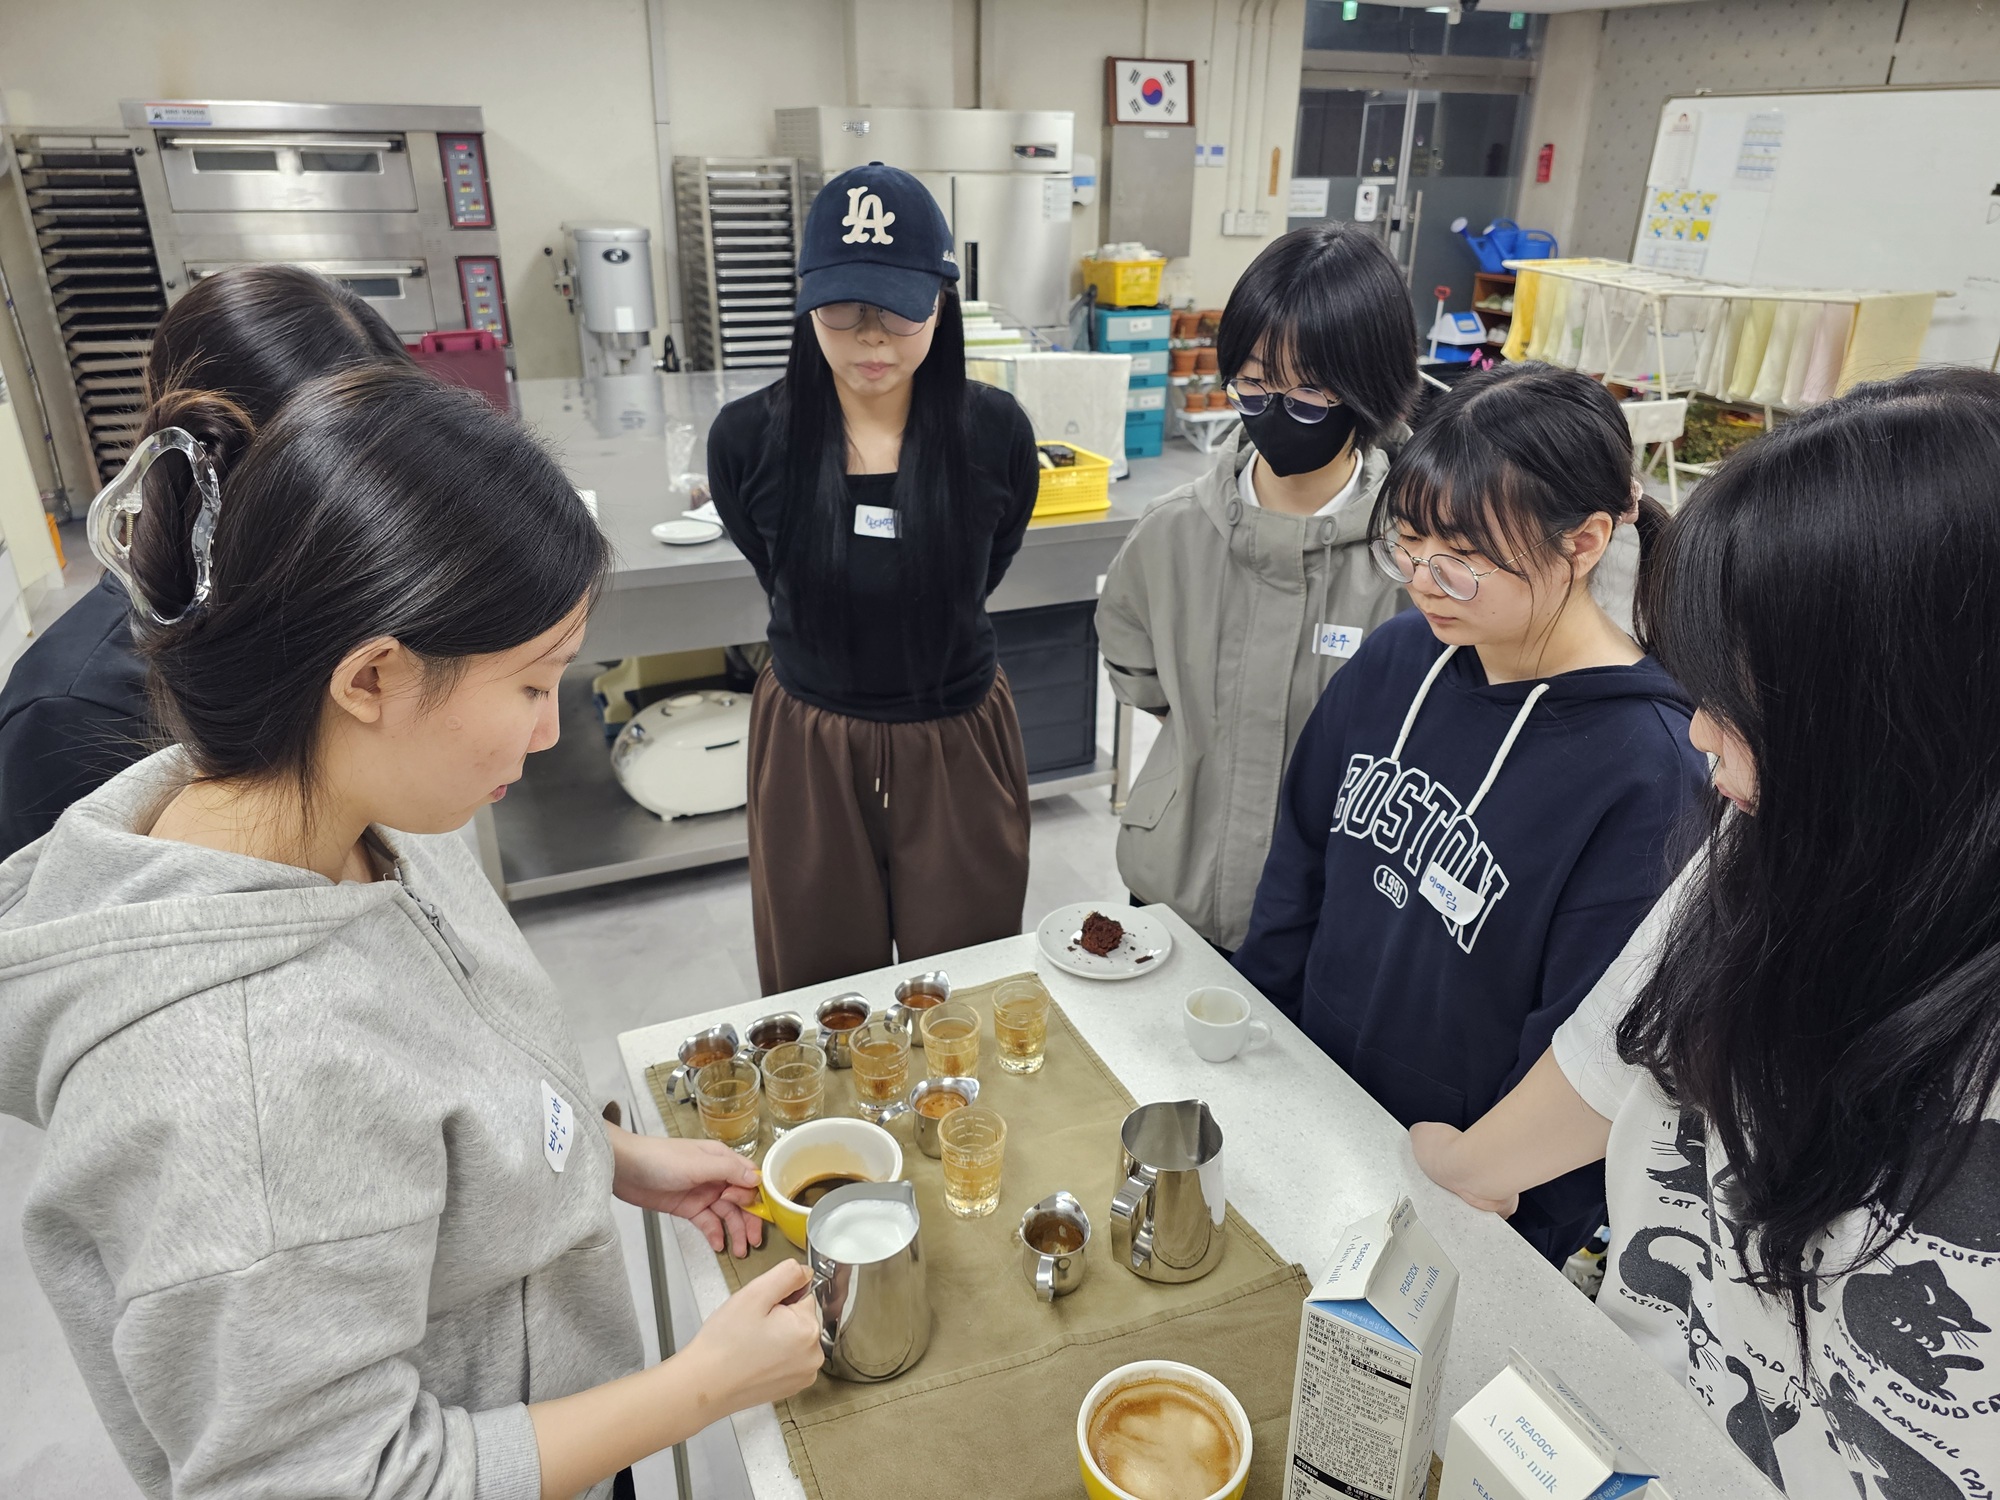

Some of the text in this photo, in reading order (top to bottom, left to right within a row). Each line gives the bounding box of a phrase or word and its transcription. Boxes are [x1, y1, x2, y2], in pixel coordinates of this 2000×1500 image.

[842, 186, 896, 245] LA
[1330, 754, 1510, 954] BOSTON
[1378, 870, 1404, 904] 1991
[1430, 876, 1458, 912] 이예림
[548, 1096, 566, 1154] 박진아
[1658, 1196, 1696, 1209] CAT
[1350, 1242, 1370, 1272] PEACOCK
[1927, 1242, 2000, 1268] FLUFF
[1399, 1263, 1420, 1296] PEACOCK
[1414, 1288, 1430, 1312] class
[1425, 1265, 1440, 1290] milk
[1619, 1287, 1690, 1340] EASILY SPO
[1688, 1376, 1715, 1406] CAT
[1823, 1344, 1866, 1393] SUPER
[1872, 1396, 1962, 1458] PLAYFUL
[1888, 1382, 1970, 1419] ROUND
[1972, 1394, 2000, 1415] CA
[1483, 1414, 1559, 1494] A class milk
[1515, 1415, 1558, 1460] PEACOCK
